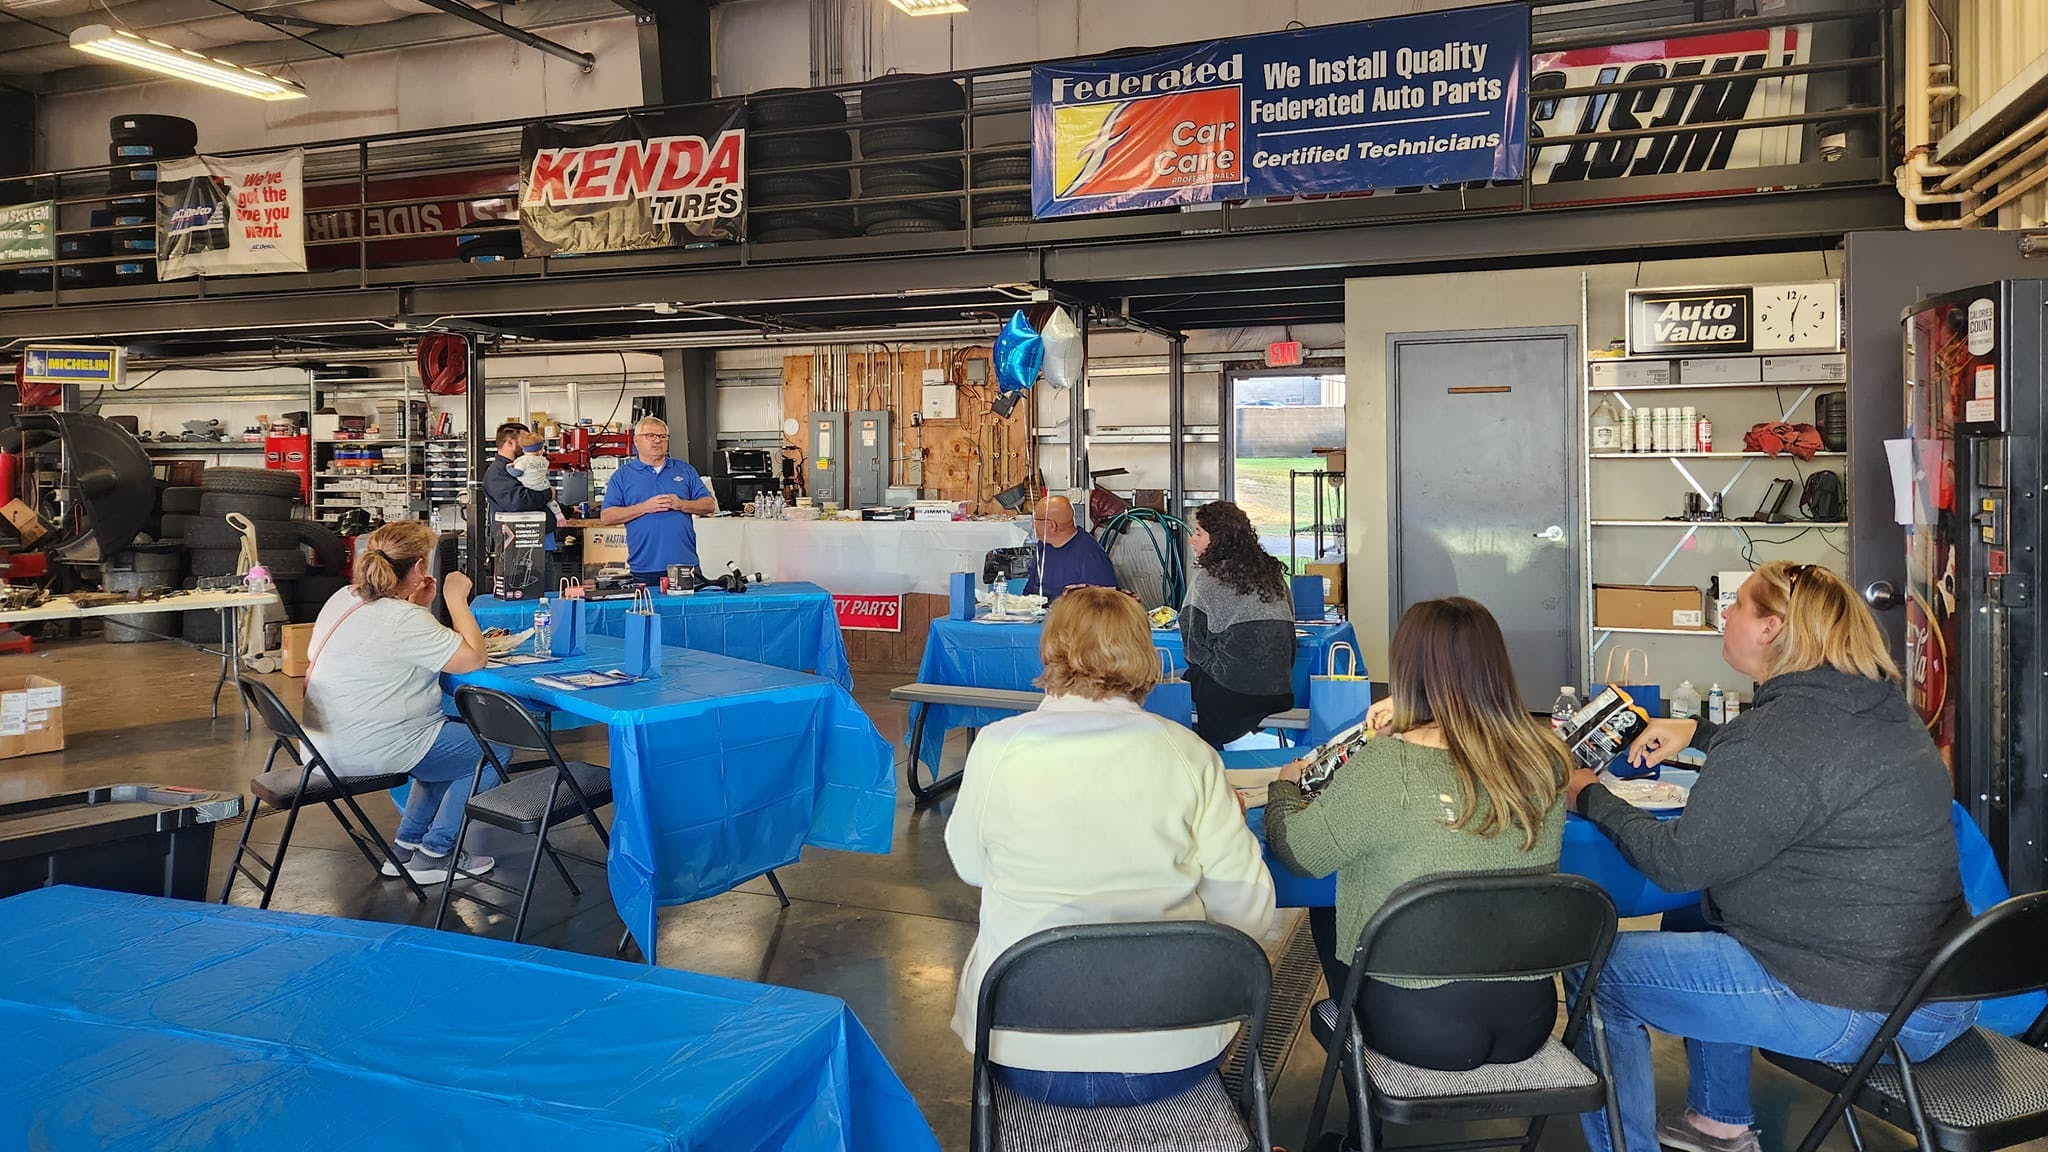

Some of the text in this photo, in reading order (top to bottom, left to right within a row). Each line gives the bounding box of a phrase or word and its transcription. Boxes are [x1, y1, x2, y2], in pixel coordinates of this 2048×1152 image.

[1263, 41, 1488, 91] We Install Quality
[1052, 54, 1243, 102] Federated
[1251, 79, 1502, 124] Federated Auto Parts
[1171, 121, 1235, 147] Car
[1252, 131, 1501, 169] Certified Technicians
[525, 131, 744, 206] KENDA
[1154, 149, 1235, 176] Care
[243, 171, 282, 187] We've
[262, 186, 287, 203] the
[653, 187, 742, 223] TIRES
[264, 206, 290, 225] you
[368, 201, 444, 237] SIDE
[245, 222, 282, 239] want.
[1786, 290, 1798, 301] 12
[1657, 299, 1733, 322] Auto
[1761, 314, 1768, 324] 9
[1818, 310, 1825, 320] 3
[1969, 308, 1993, 321] CALORIES
[1653, 321, 1737, 342] Value
[1969, 318, 1992, 334] COUNT
[1788, 333, 1795, 343] 6
[48, 358, 109, 371] MICHELIN
[604, 533, 627, 544] HASTIN
[850, 600, 898, 617] PARTS
